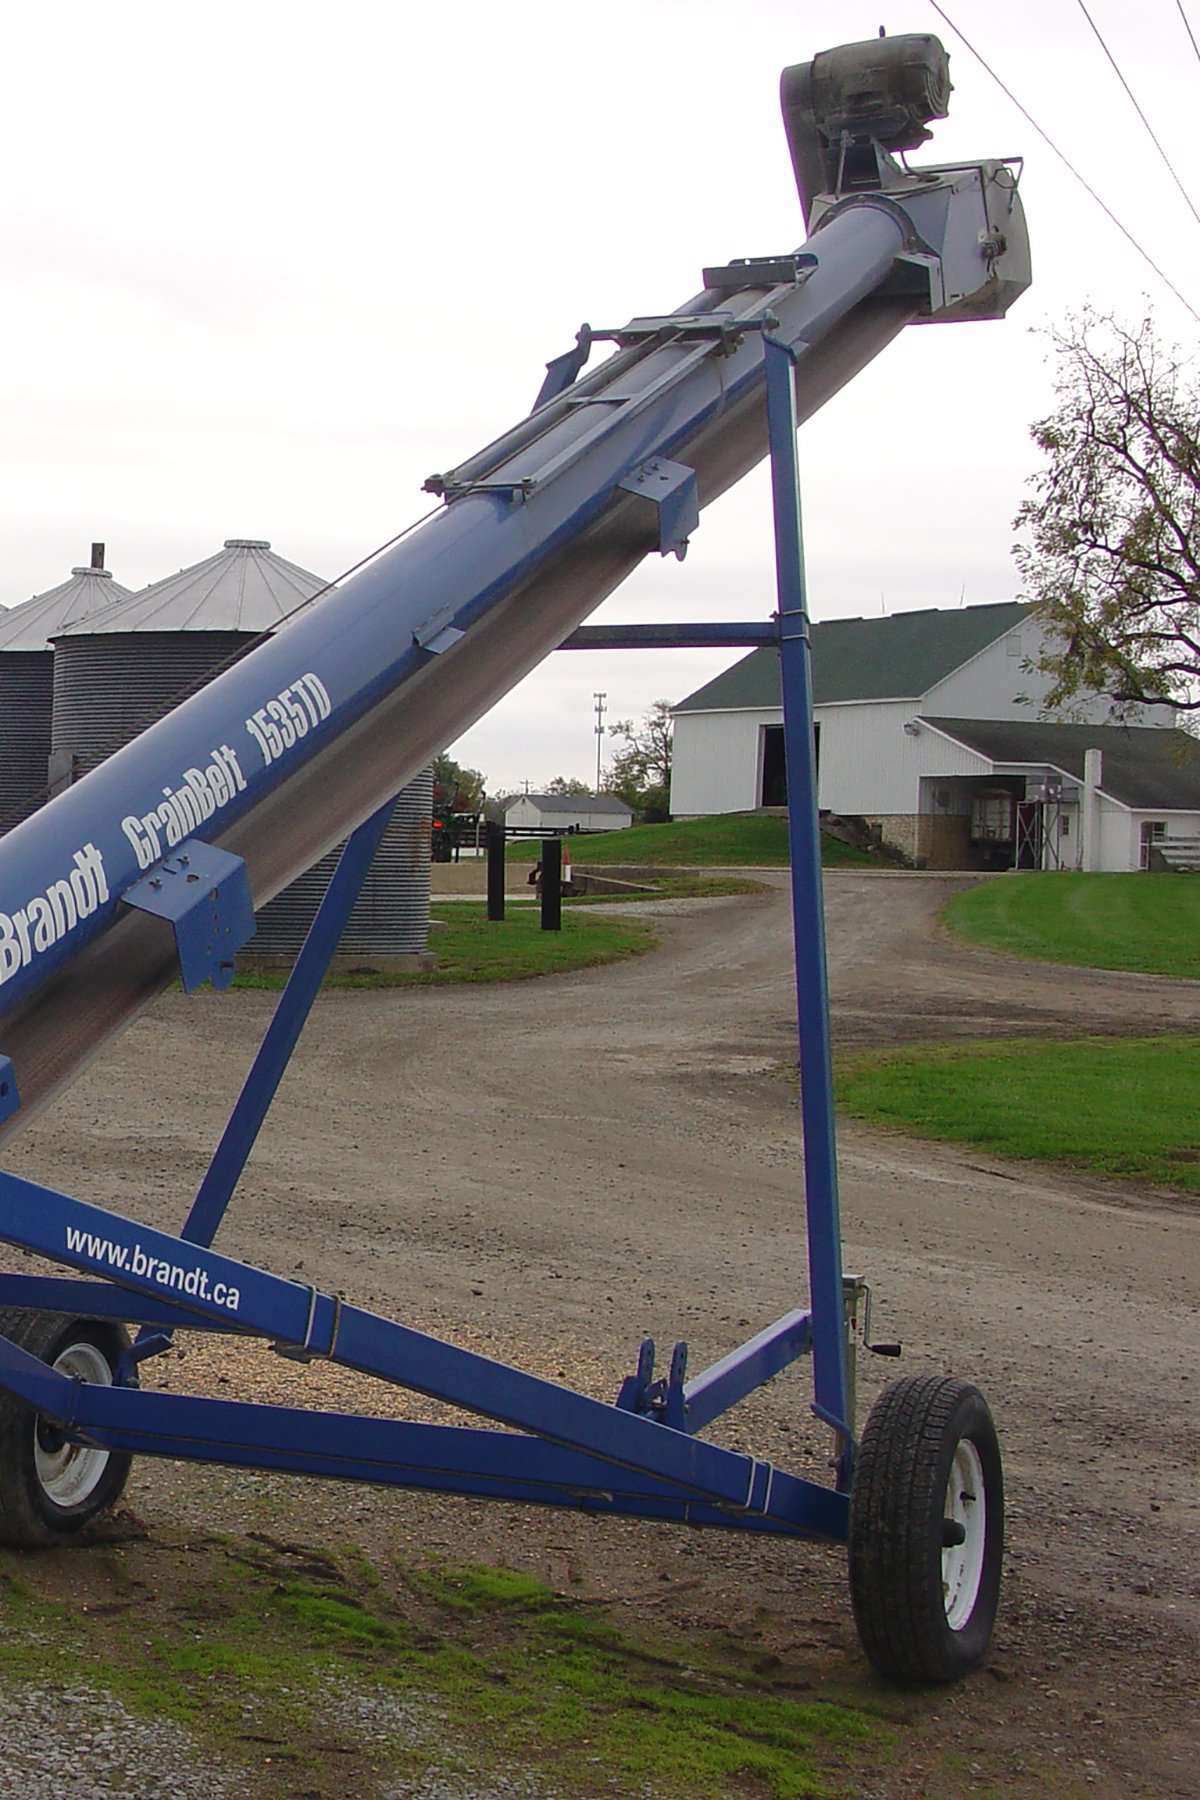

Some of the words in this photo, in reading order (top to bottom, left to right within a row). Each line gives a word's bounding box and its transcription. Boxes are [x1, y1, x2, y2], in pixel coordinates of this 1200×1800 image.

[121, 743, 247, 871] GrainBelt
[245, 671, 332, 767] 1535TD
[66, 1226, 241, 1311] www.brandt.ca
